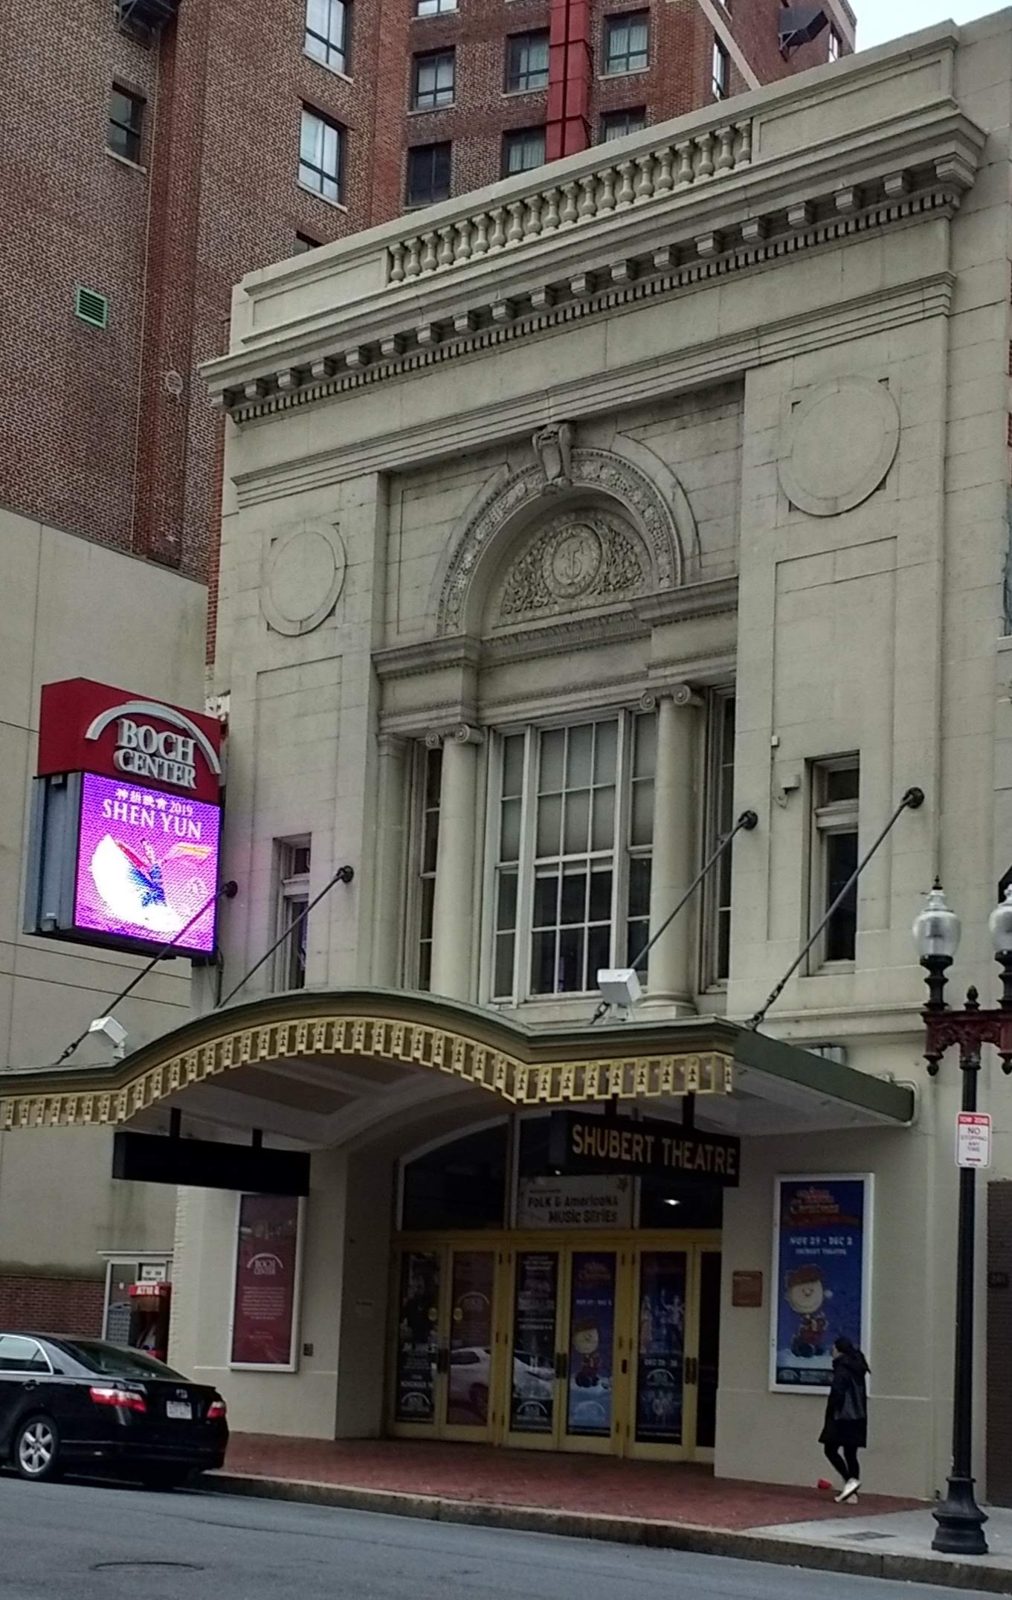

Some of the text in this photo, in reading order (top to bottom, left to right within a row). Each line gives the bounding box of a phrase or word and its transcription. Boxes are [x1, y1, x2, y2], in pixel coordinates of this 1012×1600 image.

[117, 718, 197, 767] BOCH
[113, 748, 197, 789] CENTER
[102, 798, 203, 840] SHEN YUN
[169, 800, 194, 817] 2019
[572, 1124, 737, 1175] SHUBERT THEATRE
[968, 1127, 981, 1135] NO
